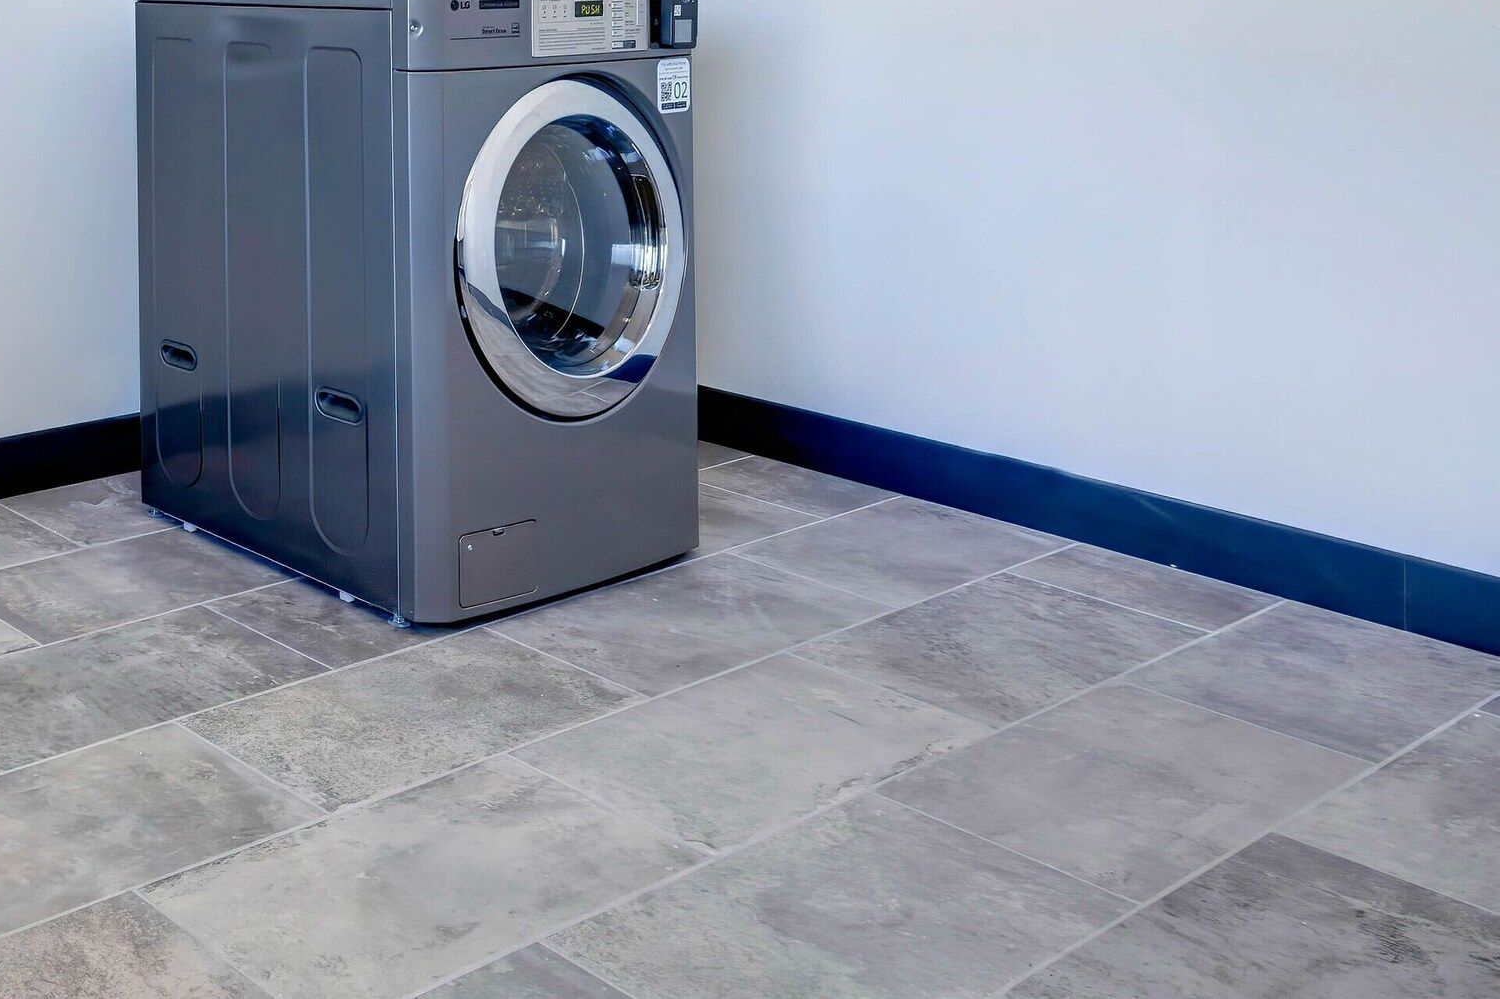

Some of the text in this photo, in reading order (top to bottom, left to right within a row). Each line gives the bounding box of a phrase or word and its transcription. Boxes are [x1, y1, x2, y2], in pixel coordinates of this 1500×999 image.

[460, 1, 470, 9] LG
[581, 4, 600, 15] PUSH
[674, 81, 688, 99] 02
